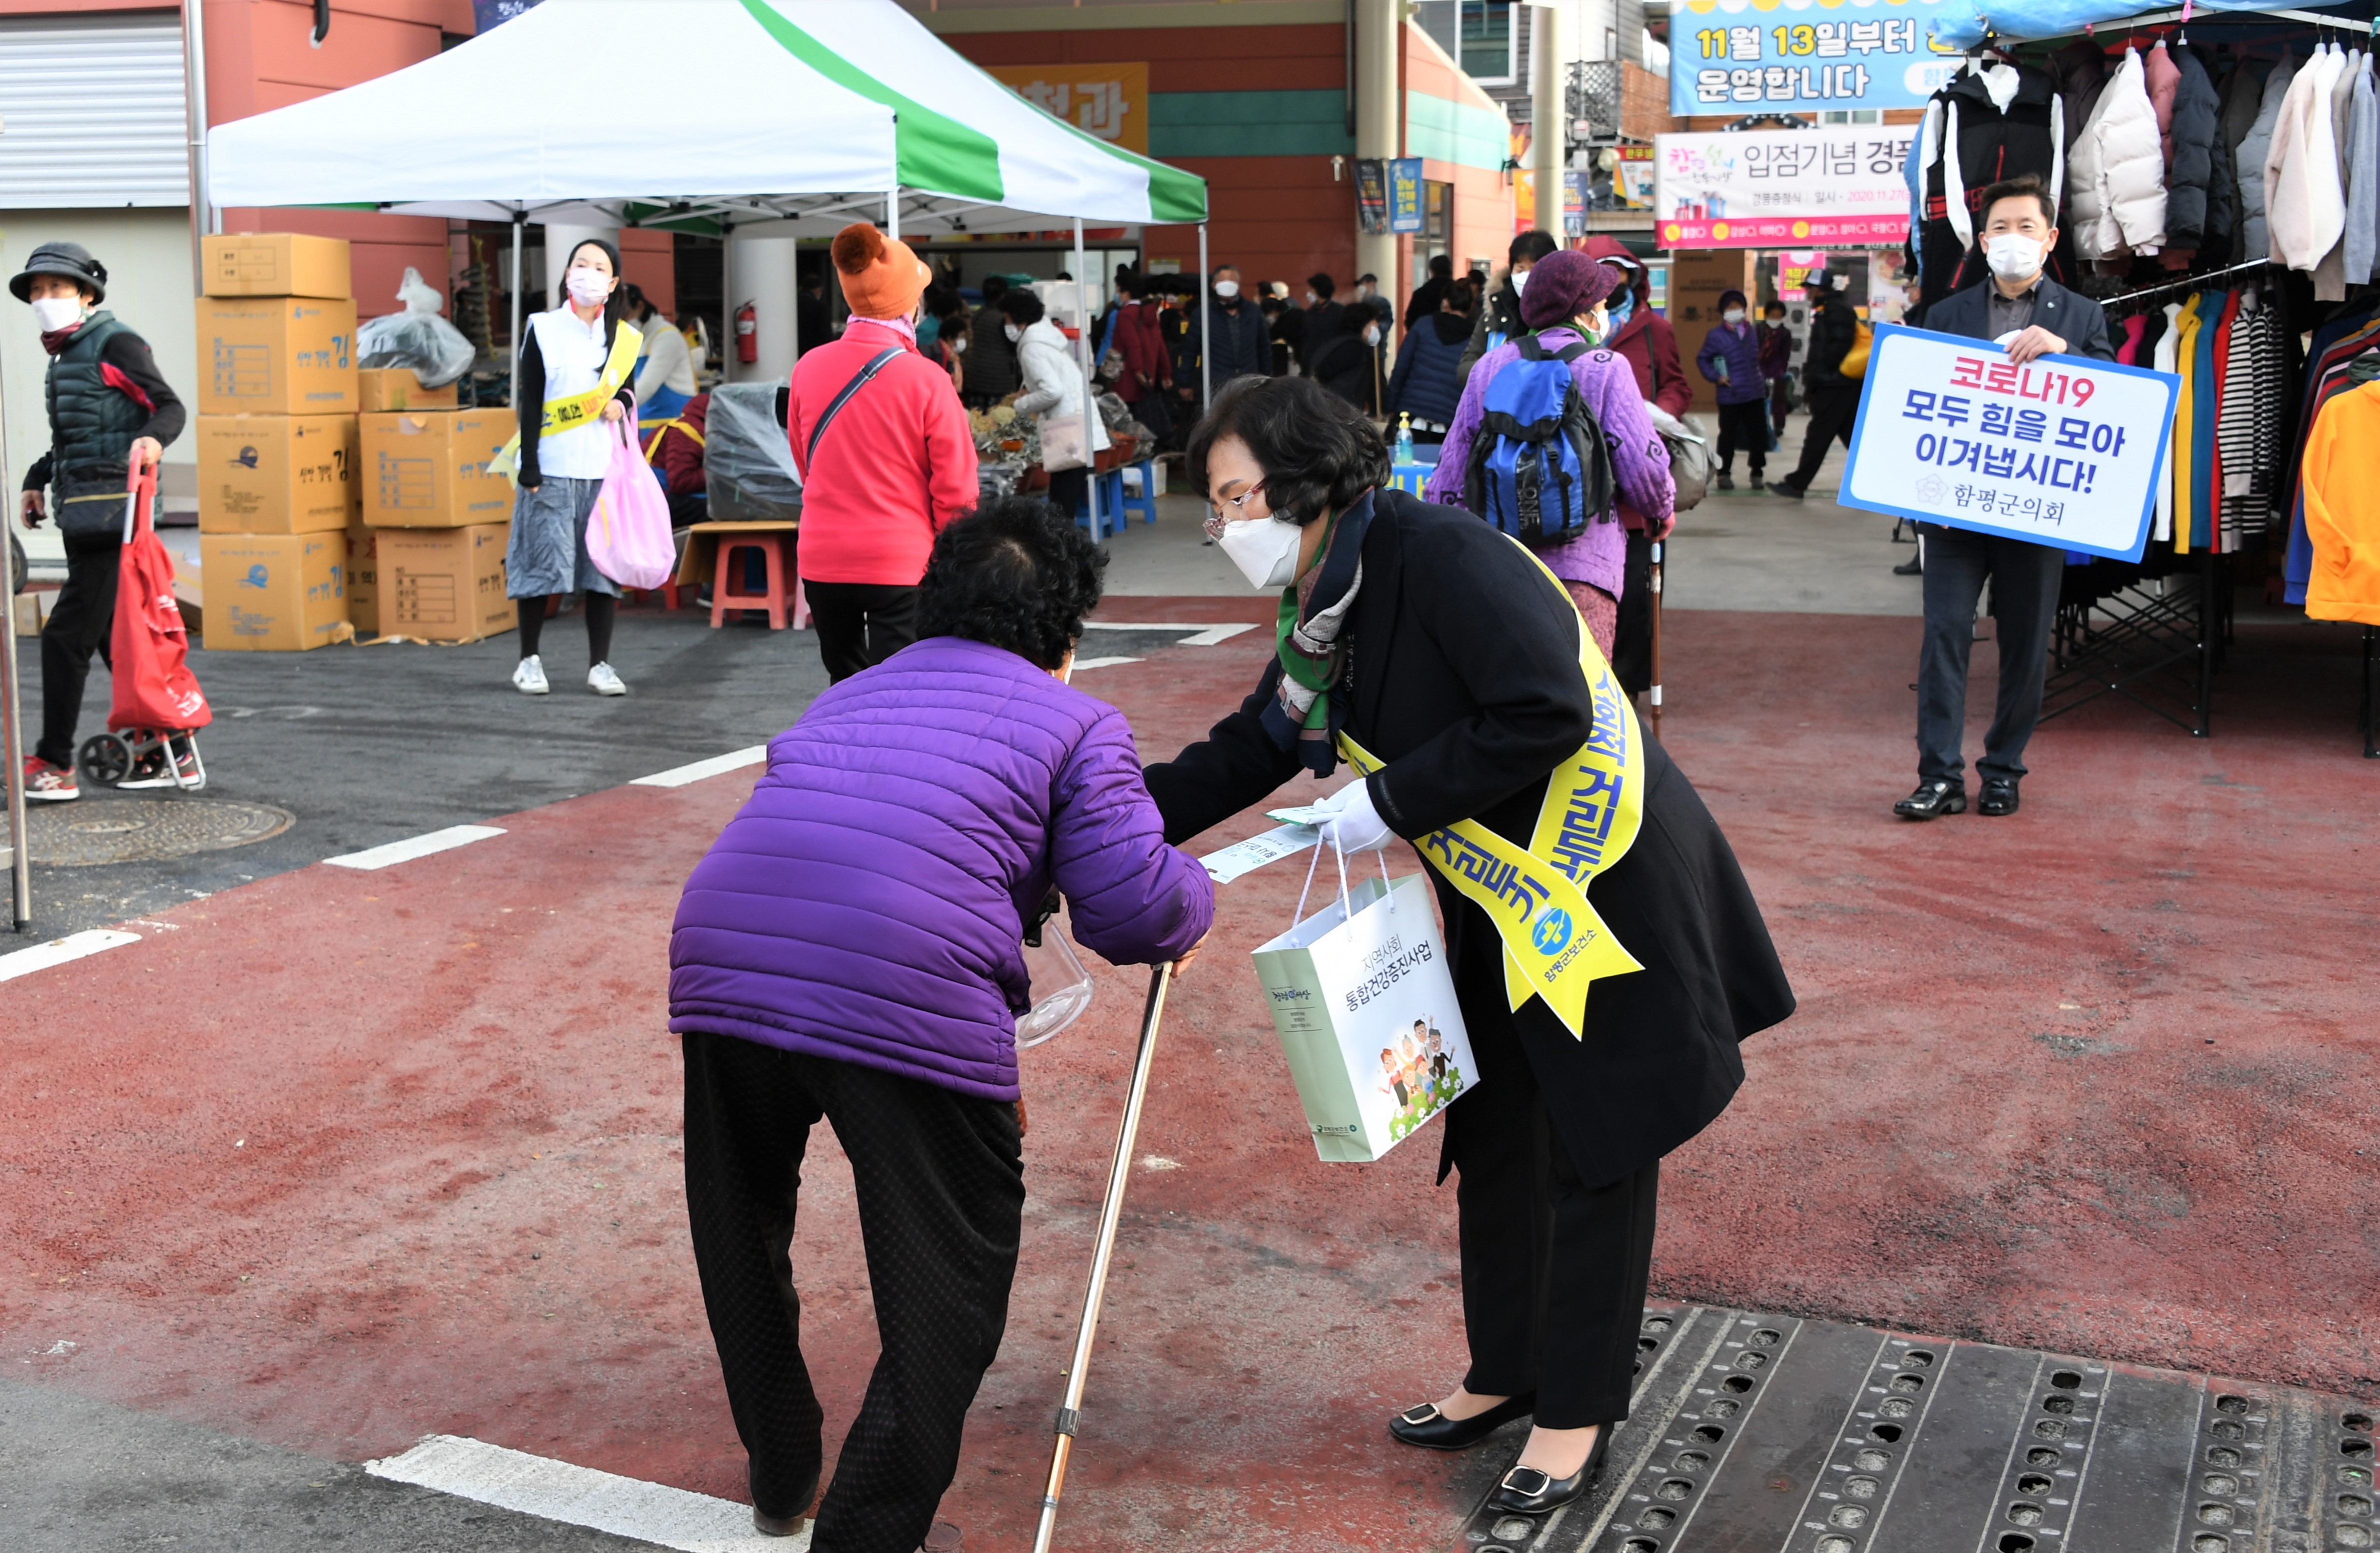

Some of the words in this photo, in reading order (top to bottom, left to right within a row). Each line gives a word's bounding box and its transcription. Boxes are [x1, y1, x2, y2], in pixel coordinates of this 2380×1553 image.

[1695, 26, 1761, 61] 11월
[1772, 18, 1915, 57] 13일부터
[1695, 63, 1870, 103] 운영합니다
[1744, 140, 1855, 178] 입점기념
[331, 334, 349, 369] 김
[1950, 356, 2096, 408] 코로나19
[1902, 388, 1972, 428] 모두
[1980, 403, 2047, 443] 힘을
[2054, 417, 2126, 458] 모아
[333, 447, 349, 481] 김
[1915, 432, 2097, 495] 이겨냅시다!
[1954, 483, 2066, 527] 함평군의회
[1426, 829, 1551, 923] 거리두기
[1361, 933, 1402, 972] 지역사회
[1543, 927, 1597, 984] 함평군보건소
[1345, 940, 1433, 1012] 통합건강증진사업
